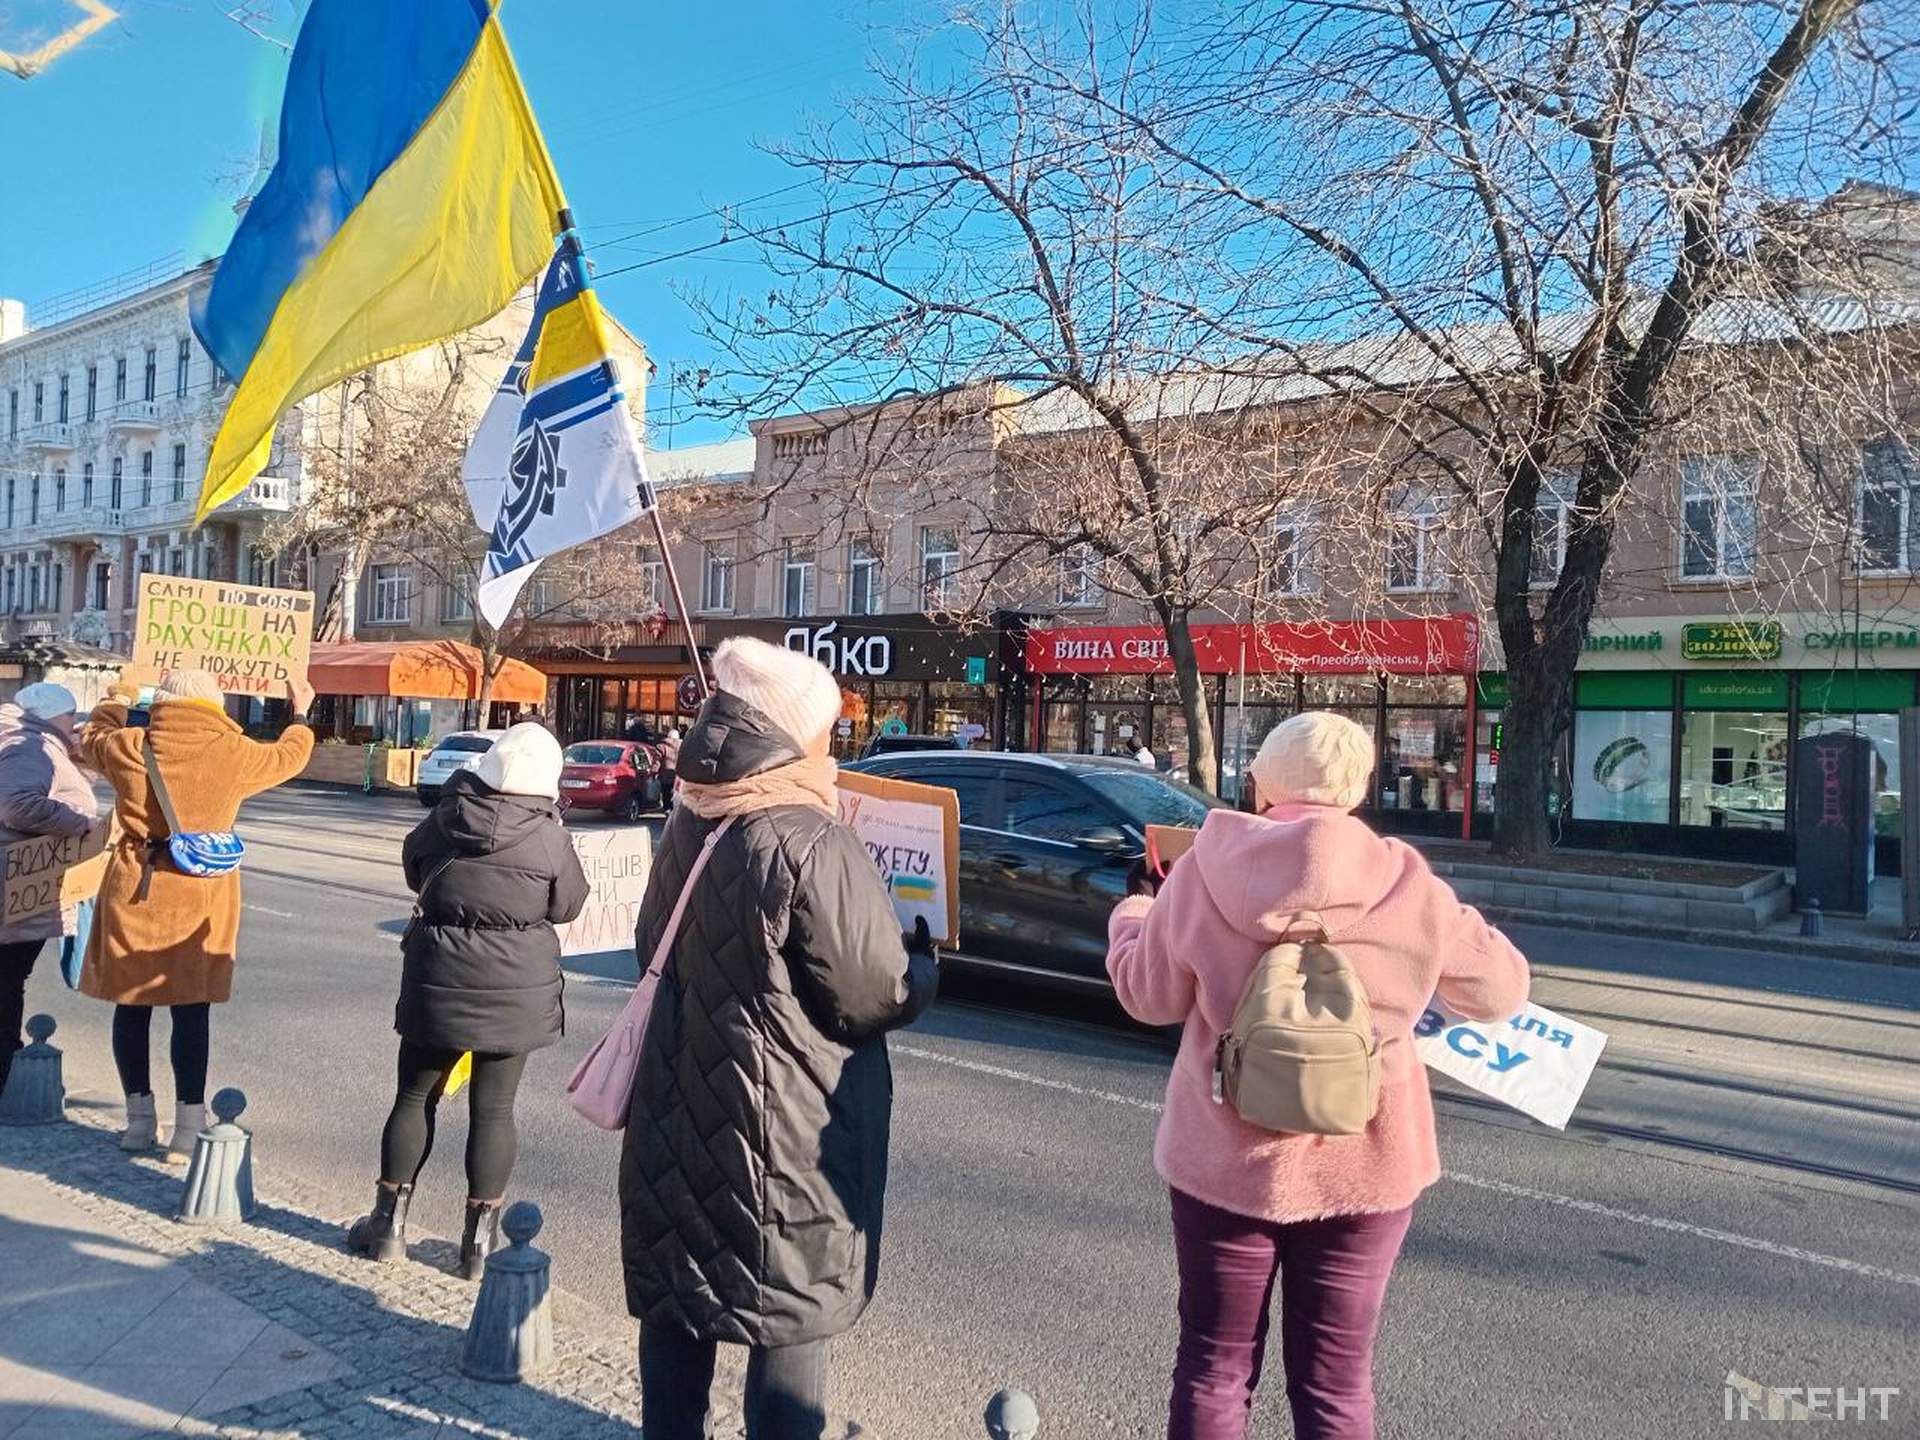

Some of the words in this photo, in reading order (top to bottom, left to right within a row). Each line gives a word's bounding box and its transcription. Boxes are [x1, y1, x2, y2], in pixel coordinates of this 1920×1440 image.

[147, 581, 204, 600] САМІ
[148, 598, 249, 630] ГРОШІ
[262, 612, 297, 635] НА
[1055, 640, 1115, 659] ВИНА
[153, 650, 183, 670] НЕ
[200, 655, 288, 680] МОЖУТЬ
